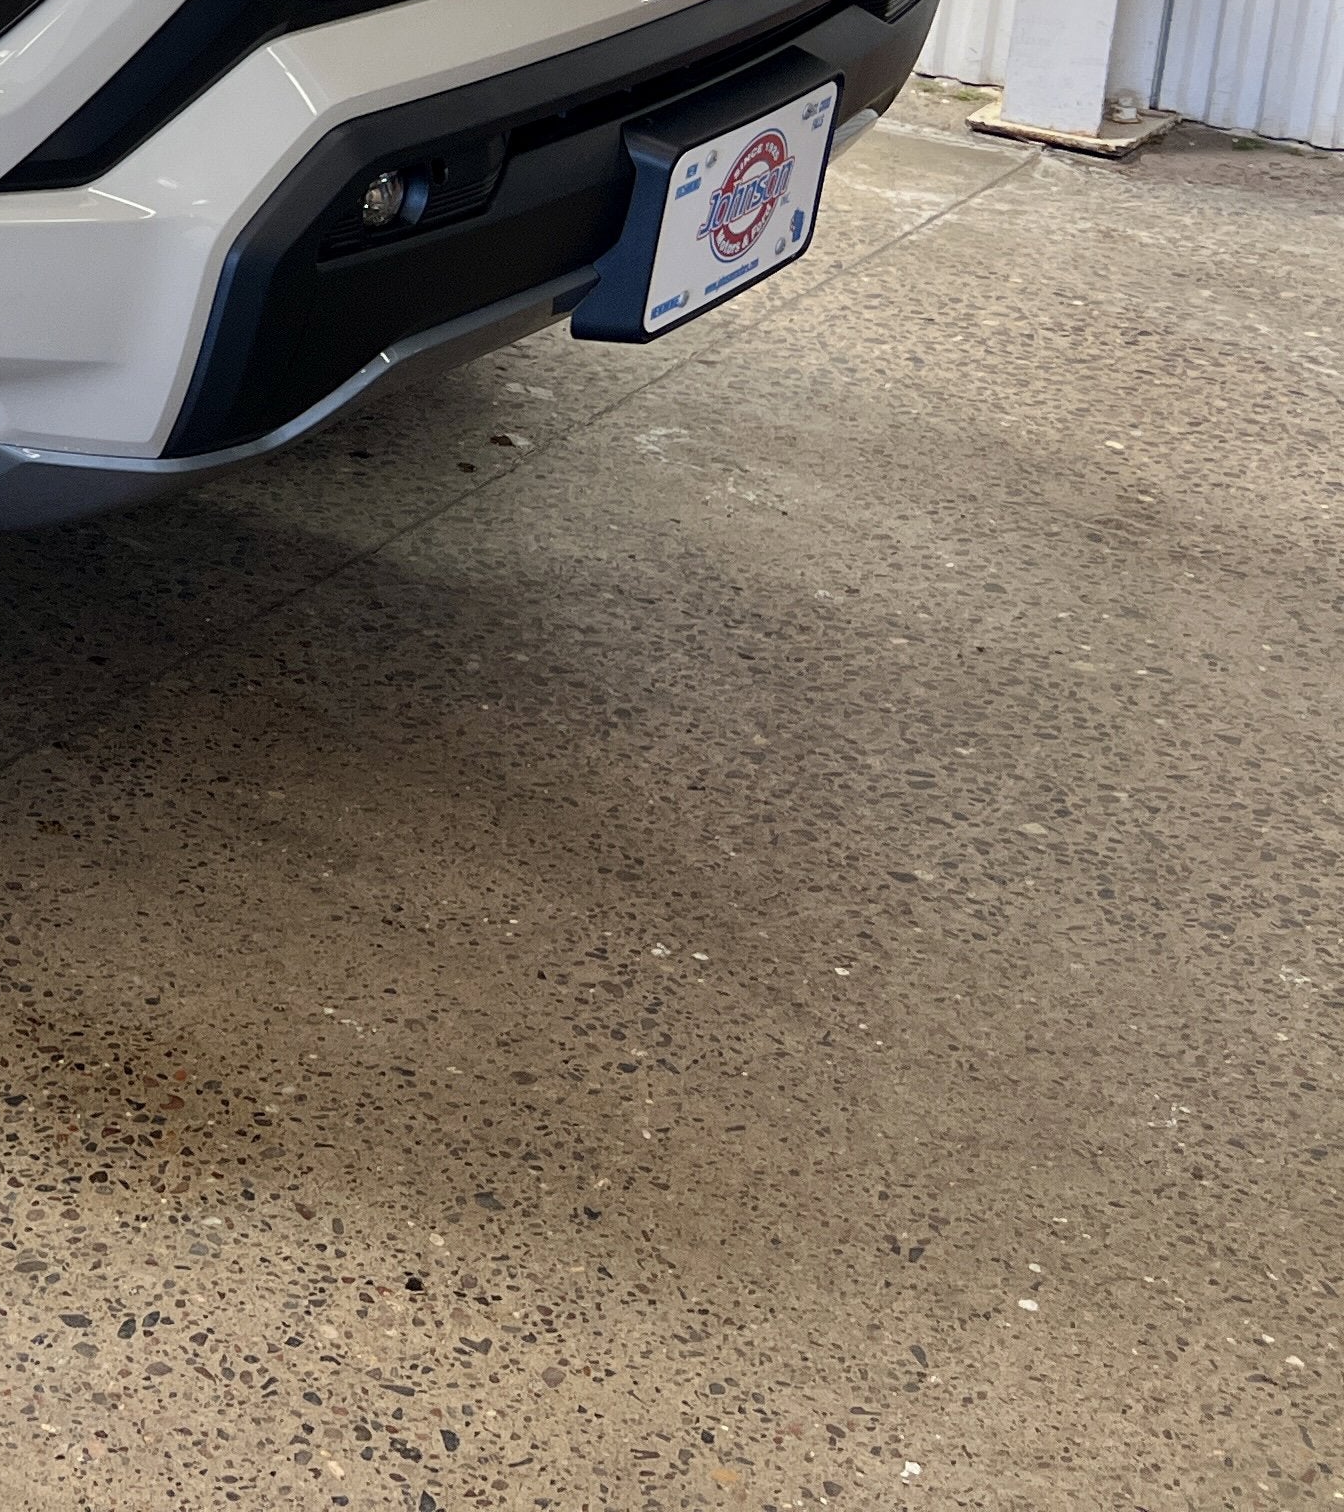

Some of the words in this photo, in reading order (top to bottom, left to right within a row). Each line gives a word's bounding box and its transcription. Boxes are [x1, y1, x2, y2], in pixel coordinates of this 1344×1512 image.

[733, 143, 763, 179] SINCE
[697, 156, 794, 240] Johnson
[716, 228, 741, 255] Motors
[741, 233, 750, 249] &
